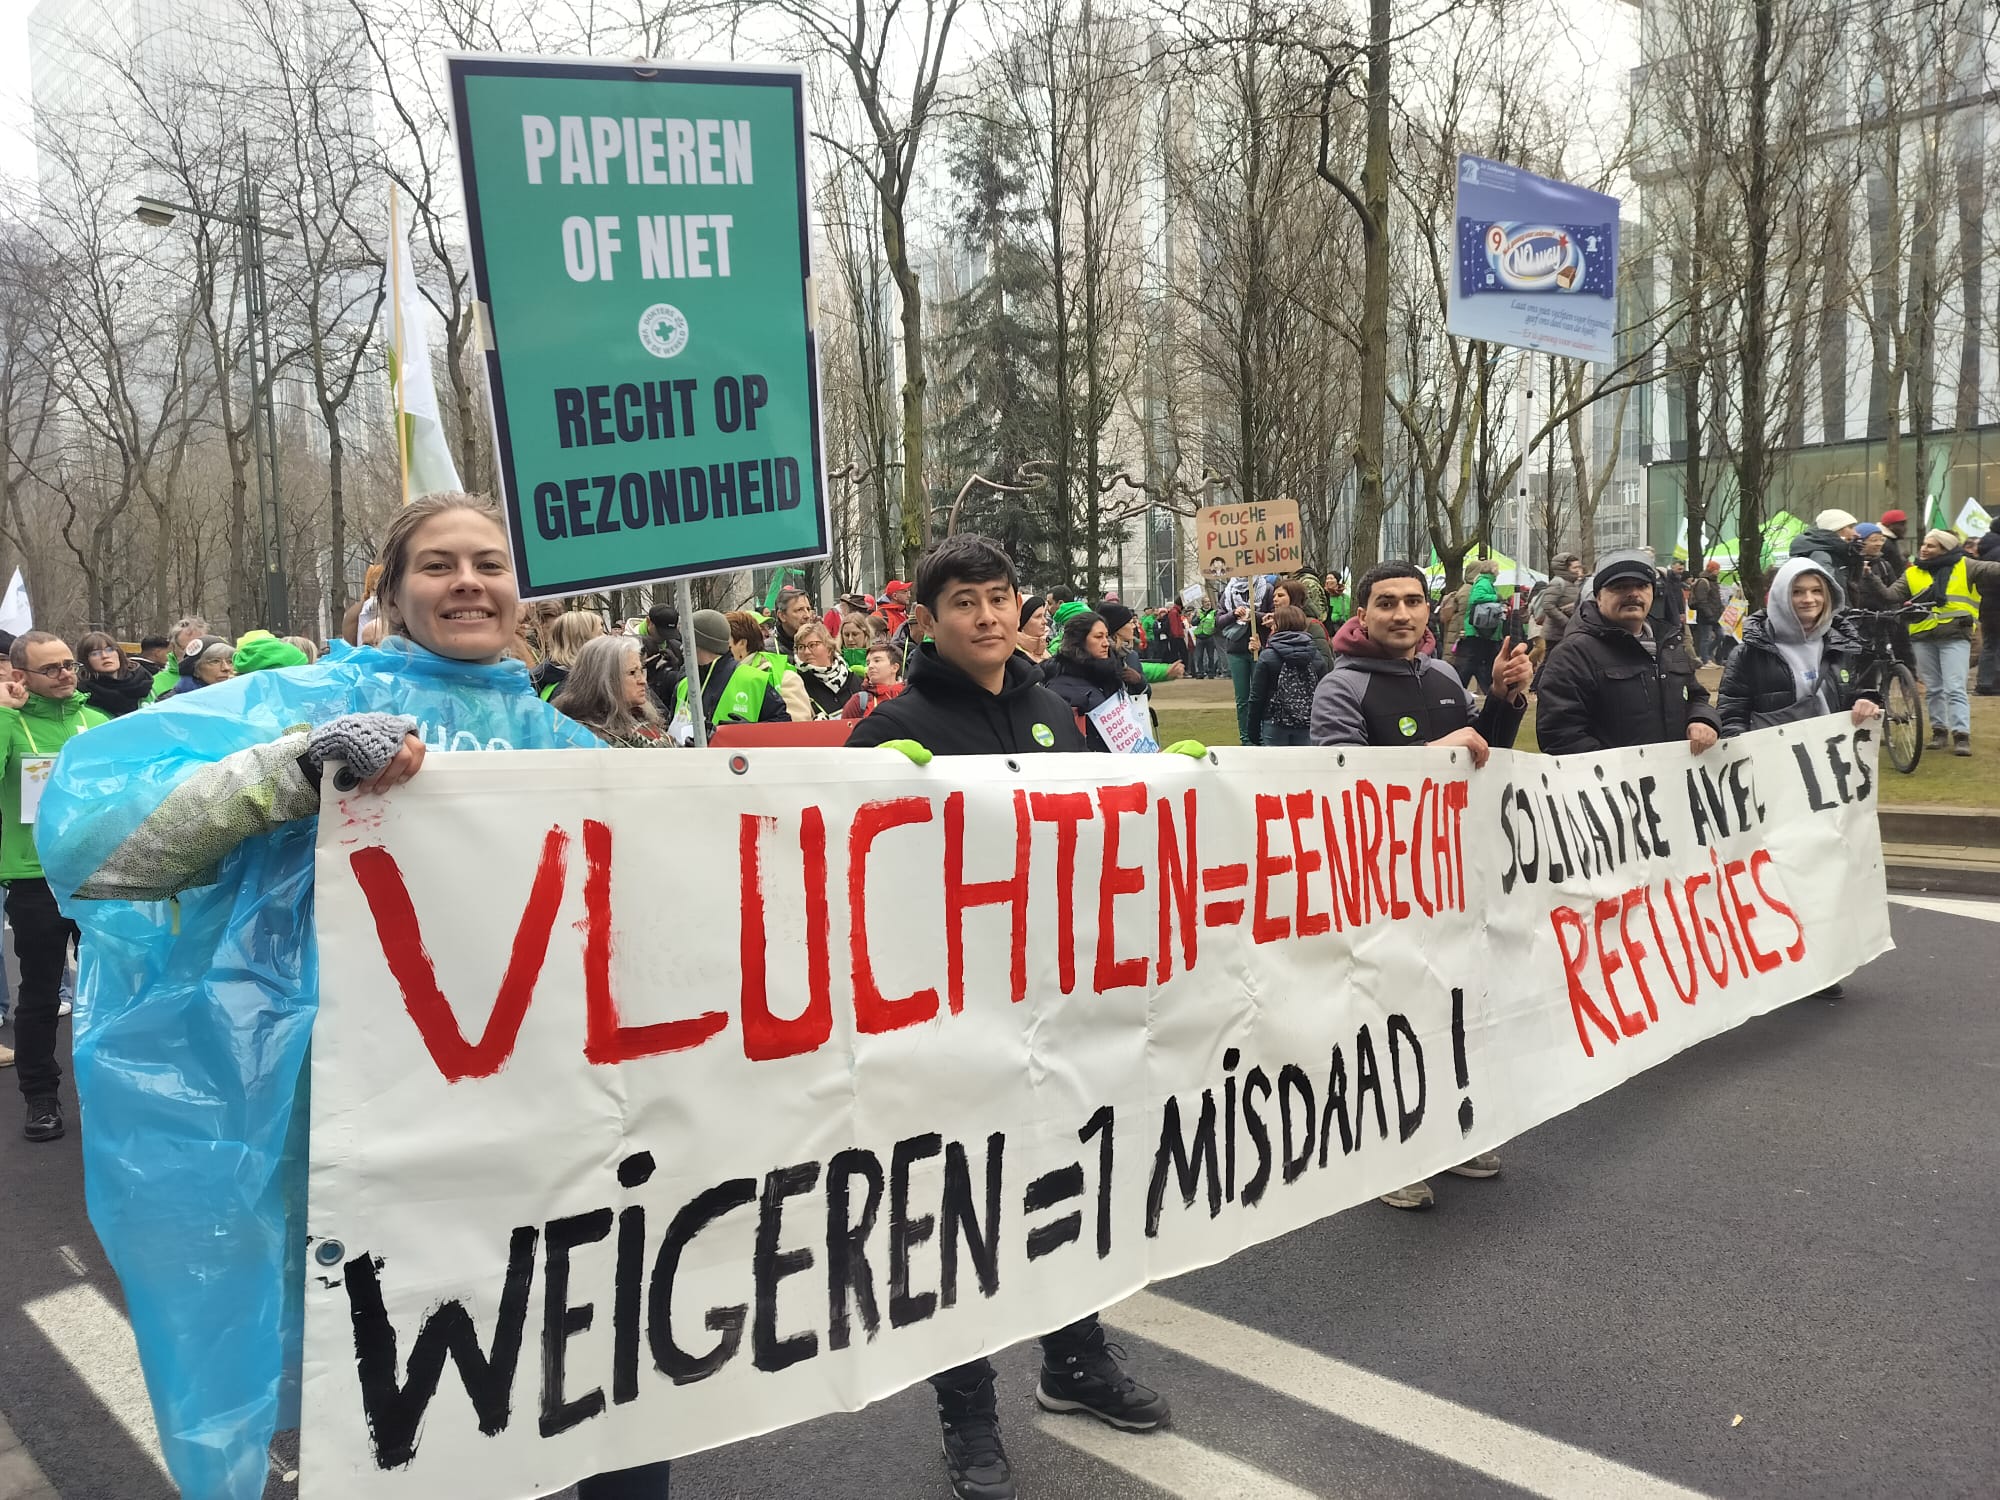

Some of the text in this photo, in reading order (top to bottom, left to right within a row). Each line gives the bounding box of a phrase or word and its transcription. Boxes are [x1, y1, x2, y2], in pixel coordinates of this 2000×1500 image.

[521, 115, 754, 185] PAPIEREN
[561, 214, 734, 283] OF NIET
[1492, 231, 1502, 251] 9
[1514, 243, 1534, 273] NO
[554, 374, 769, 449] RECHT OP
[533, 456, 801, 541] GEZONDHEID
[1208, 506, 1267, 526] TOUCHE
[1206, 528, 1248, 550] PLUS
[1275, 521, 1295, 541] MA
[1105, 716, 1125, 736] pour
[1111, 723, 1134, 743] notre
[1116, 727, 1142, 752] travail
[1791, 728, 1873, 812] LES
